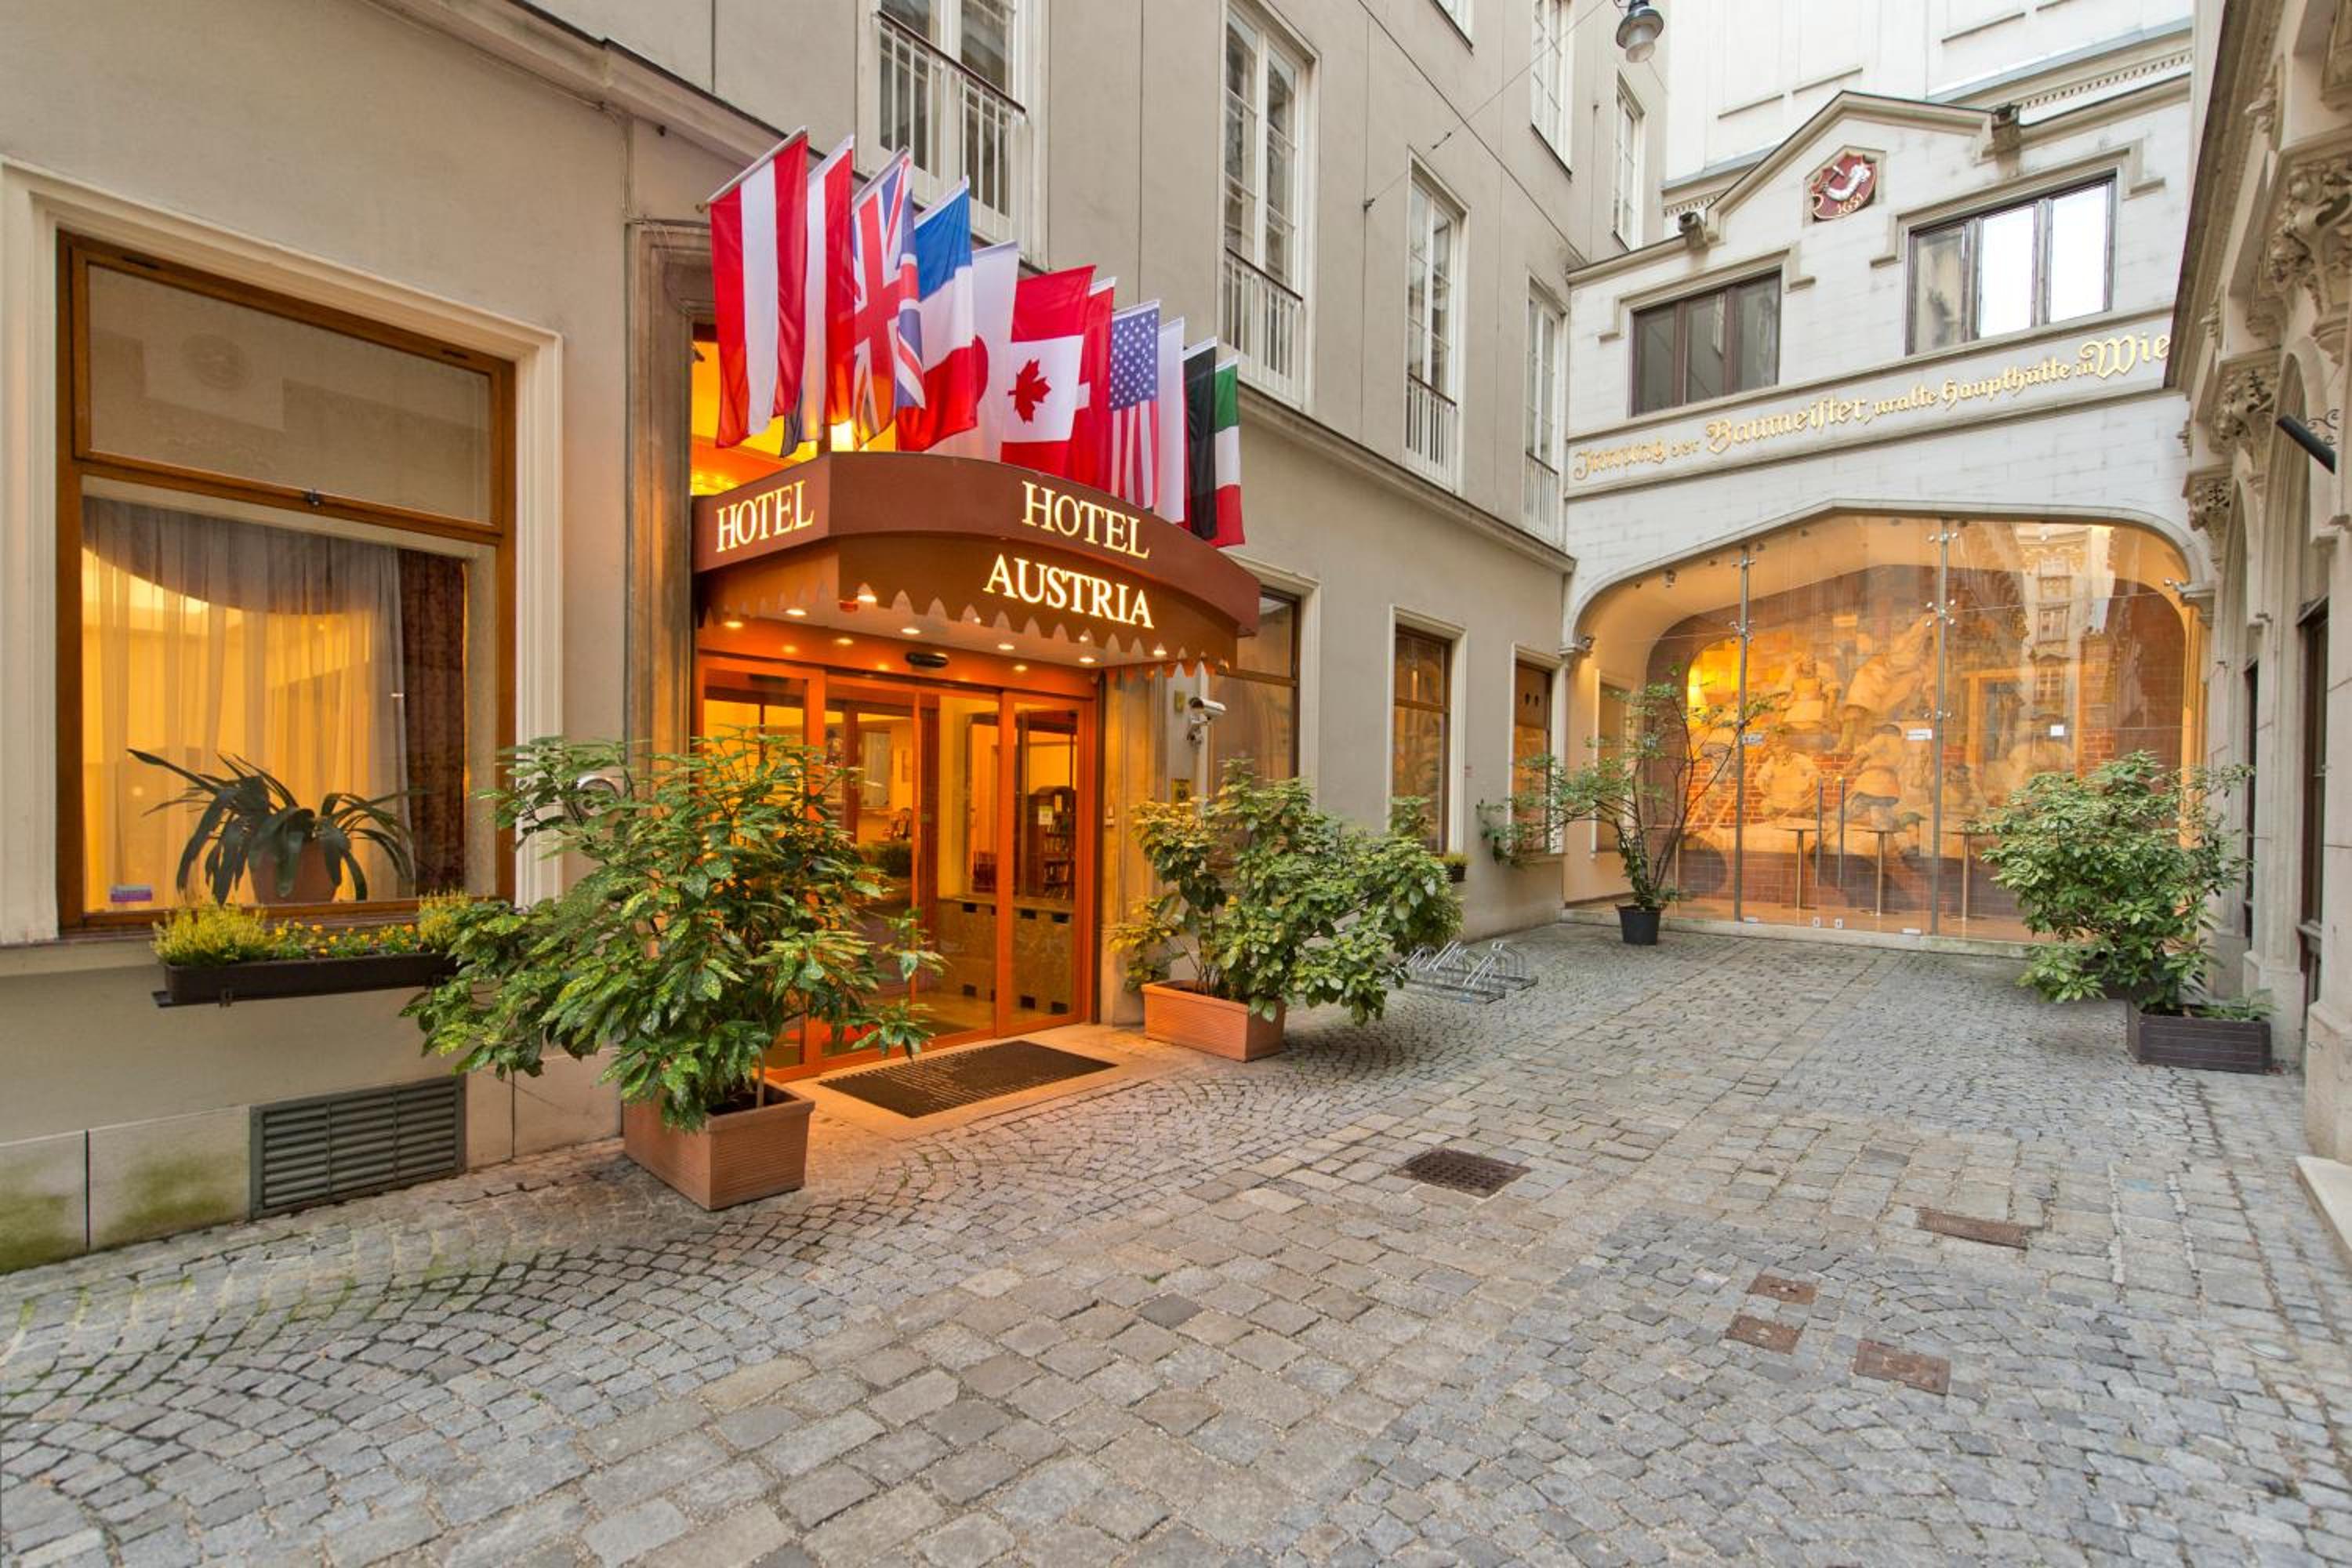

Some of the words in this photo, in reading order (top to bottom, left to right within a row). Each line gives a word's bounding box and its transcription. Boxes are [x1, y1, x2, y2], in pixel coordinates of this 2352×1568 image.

[715, 479, 815, 554] HOTEL
[1020, 479, 1152, 560] HOTEL
[982, 553, 1155, 630] AUSTRIA
